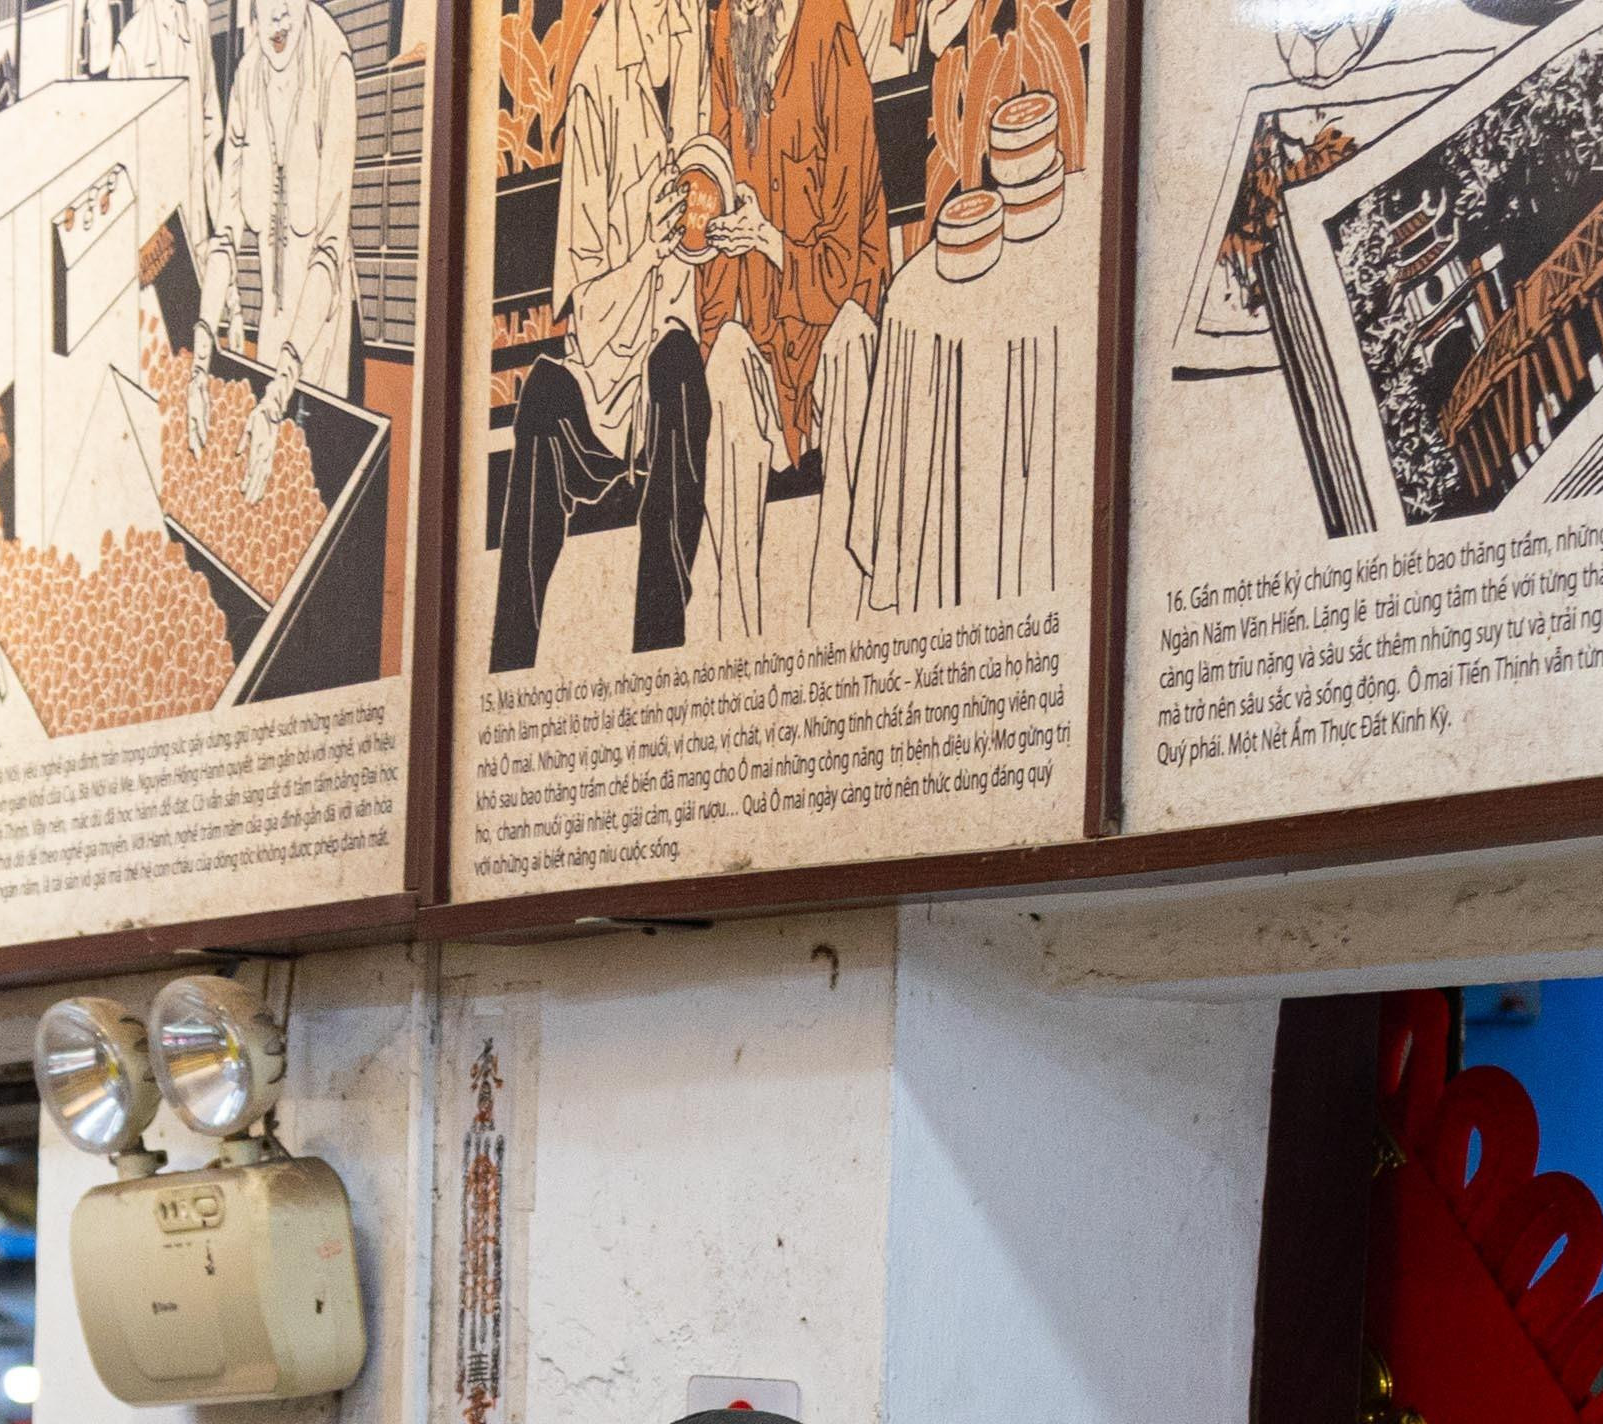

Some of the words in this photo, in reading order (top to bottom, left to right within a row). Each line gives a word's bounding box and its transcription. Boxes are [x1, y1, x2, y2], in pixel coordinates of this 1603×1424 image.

[1159, 621, 1199, 657] Ngàn
[1202, 620, 1237, 646] Năm
[1239, 615, 1268, 640] Văn
[1312, 603, 1350, 633] Lặng
[1374, 592, 1400, 620] trải
[1445, 583, 1477, 609] tâm
[1480, 573, 1509, 604] thế
[1511, 571, 1537, 599] với
[1539, 568, 1579, 598] từng
[1166, 588, 1187, 614] 16.
[1222, 578, 1253, 608] một
[1255, 569, 1281, 599] thế
[1303, 564, 1353, 593] chứng
[1355, 553, 1388, 584] kiến
[1391, 547, 1423, 578] biết
[1425, 547, 1457, 573] bao
[1459, 540, 1507, 569] thăng
[1159, 664, 1195, 692] càng
[1197, 652, 1225, 684] làm
[1256, 650, 1295, 680] nặng
[1297, 644, 1315, 670] và
[1318, 641, 1345, 667] sâu
[1347, 634, 1373, 663] sắc
[1375, 631, 1417, 659] thêm
[1419, 624, 1473, 653] những
[1475, 622, 1503, 649] suy
[1506, 616, 1524, 640] tư
[1527, 610, 1546, 637] và
[1549, 608, 1577, 636] trải
[1157, 701, 1181, 730] mà
[1183, 697, 1207, 724] trở
[1207, 695, 1236, 721] nên
[1239, 691, 1265, 717] sâu
[1267, 684, 1292, 713] sắc
[1294, 683, 1313, 709] và
[1314, 677, 1353, 710] sống
[1407, 664, 1422, 693] Ô
[1423, 663, 1453, 691] mai
[1458, 656, 1491, 686] Tiến
[1495, 651, 1540, 685] Thịnh
[1156, 738, 1187, 768] Quý
[1188, 733, 1225, 767] phái.
[1227, 729, 1259, 760] Một
[1320, 717, 1358, 747] Thực
[1359, 709, 1388, 739] Đất
[1390, 706, 1426, 735] Kinh
[1429, 703, 1452, 735] Kỳ.
